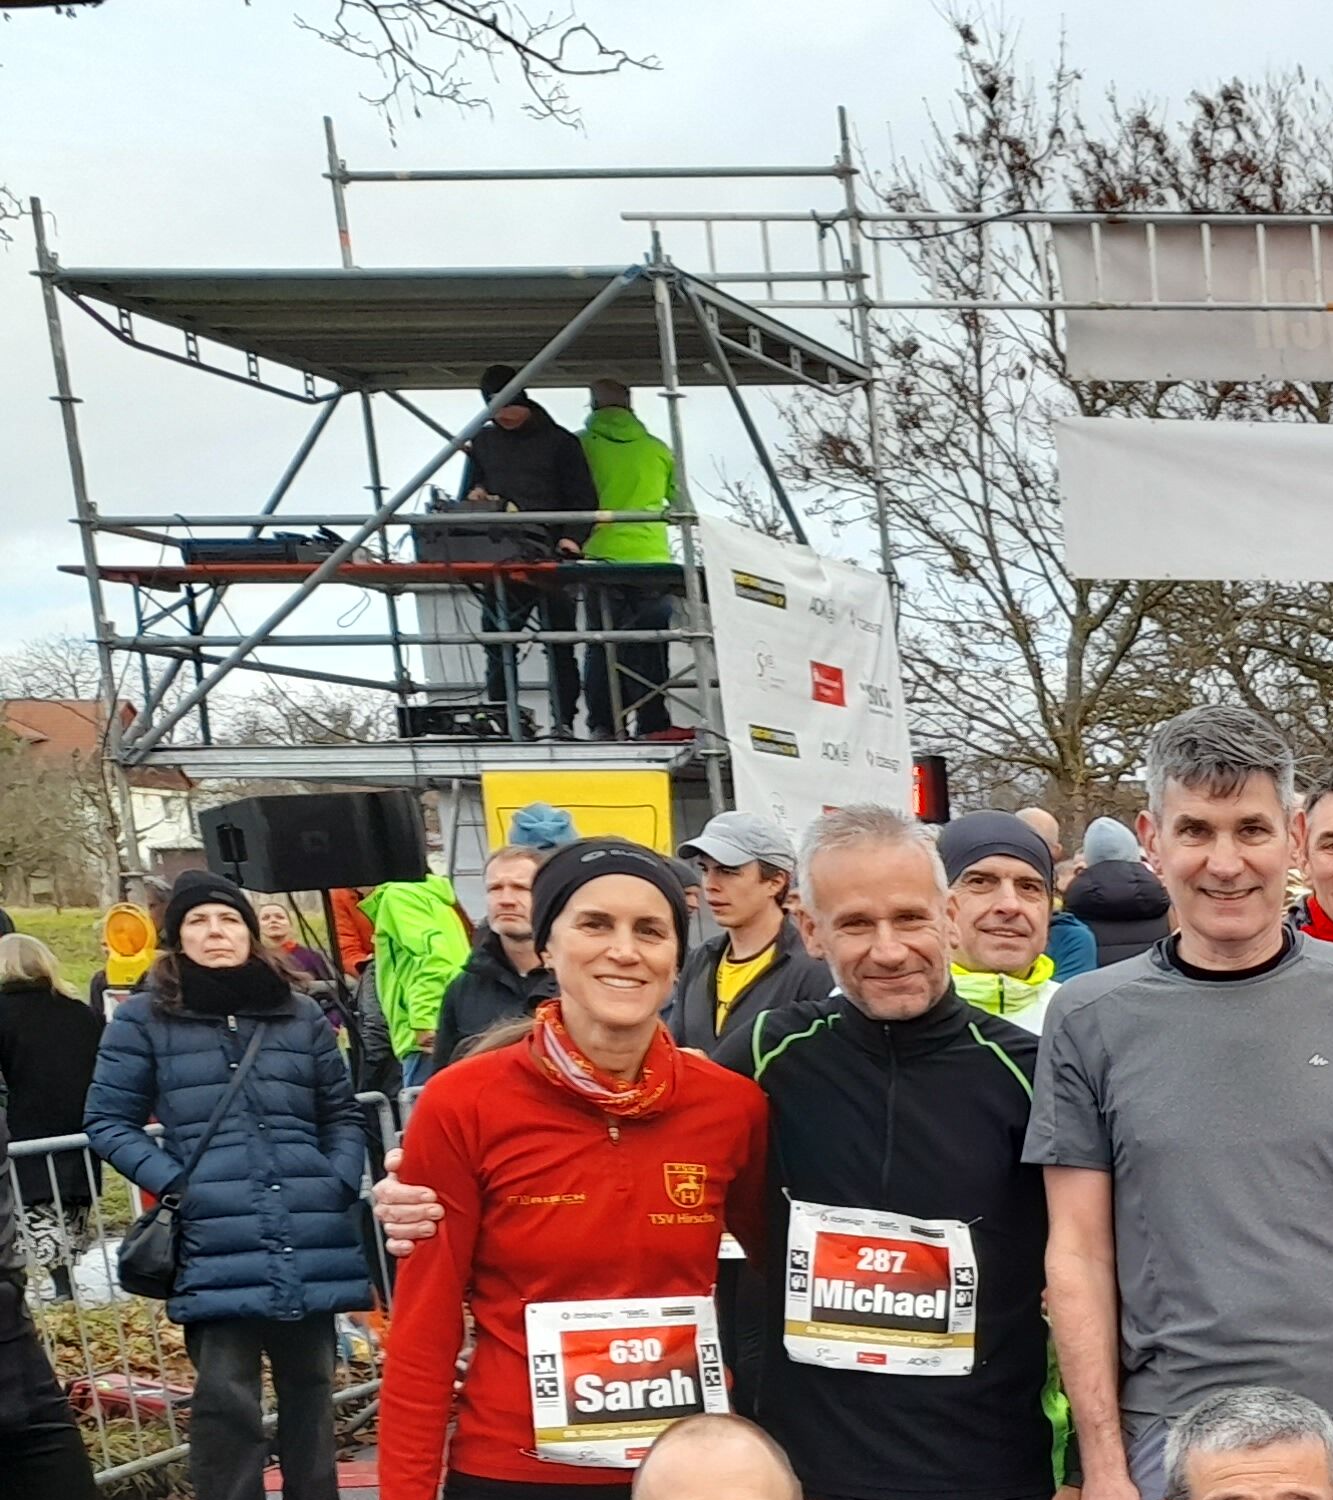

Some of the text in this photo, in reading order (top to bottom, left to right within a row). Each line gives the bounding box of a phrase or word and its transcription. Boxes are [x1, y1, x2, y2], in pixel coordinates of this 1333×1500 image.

[856, 1247, 908, 1274] 287
[813, 1277, 947, 1320] Michael
[608, 1337, 662, 1366] 630
[573, 1368, 697, 1414] Sarah
